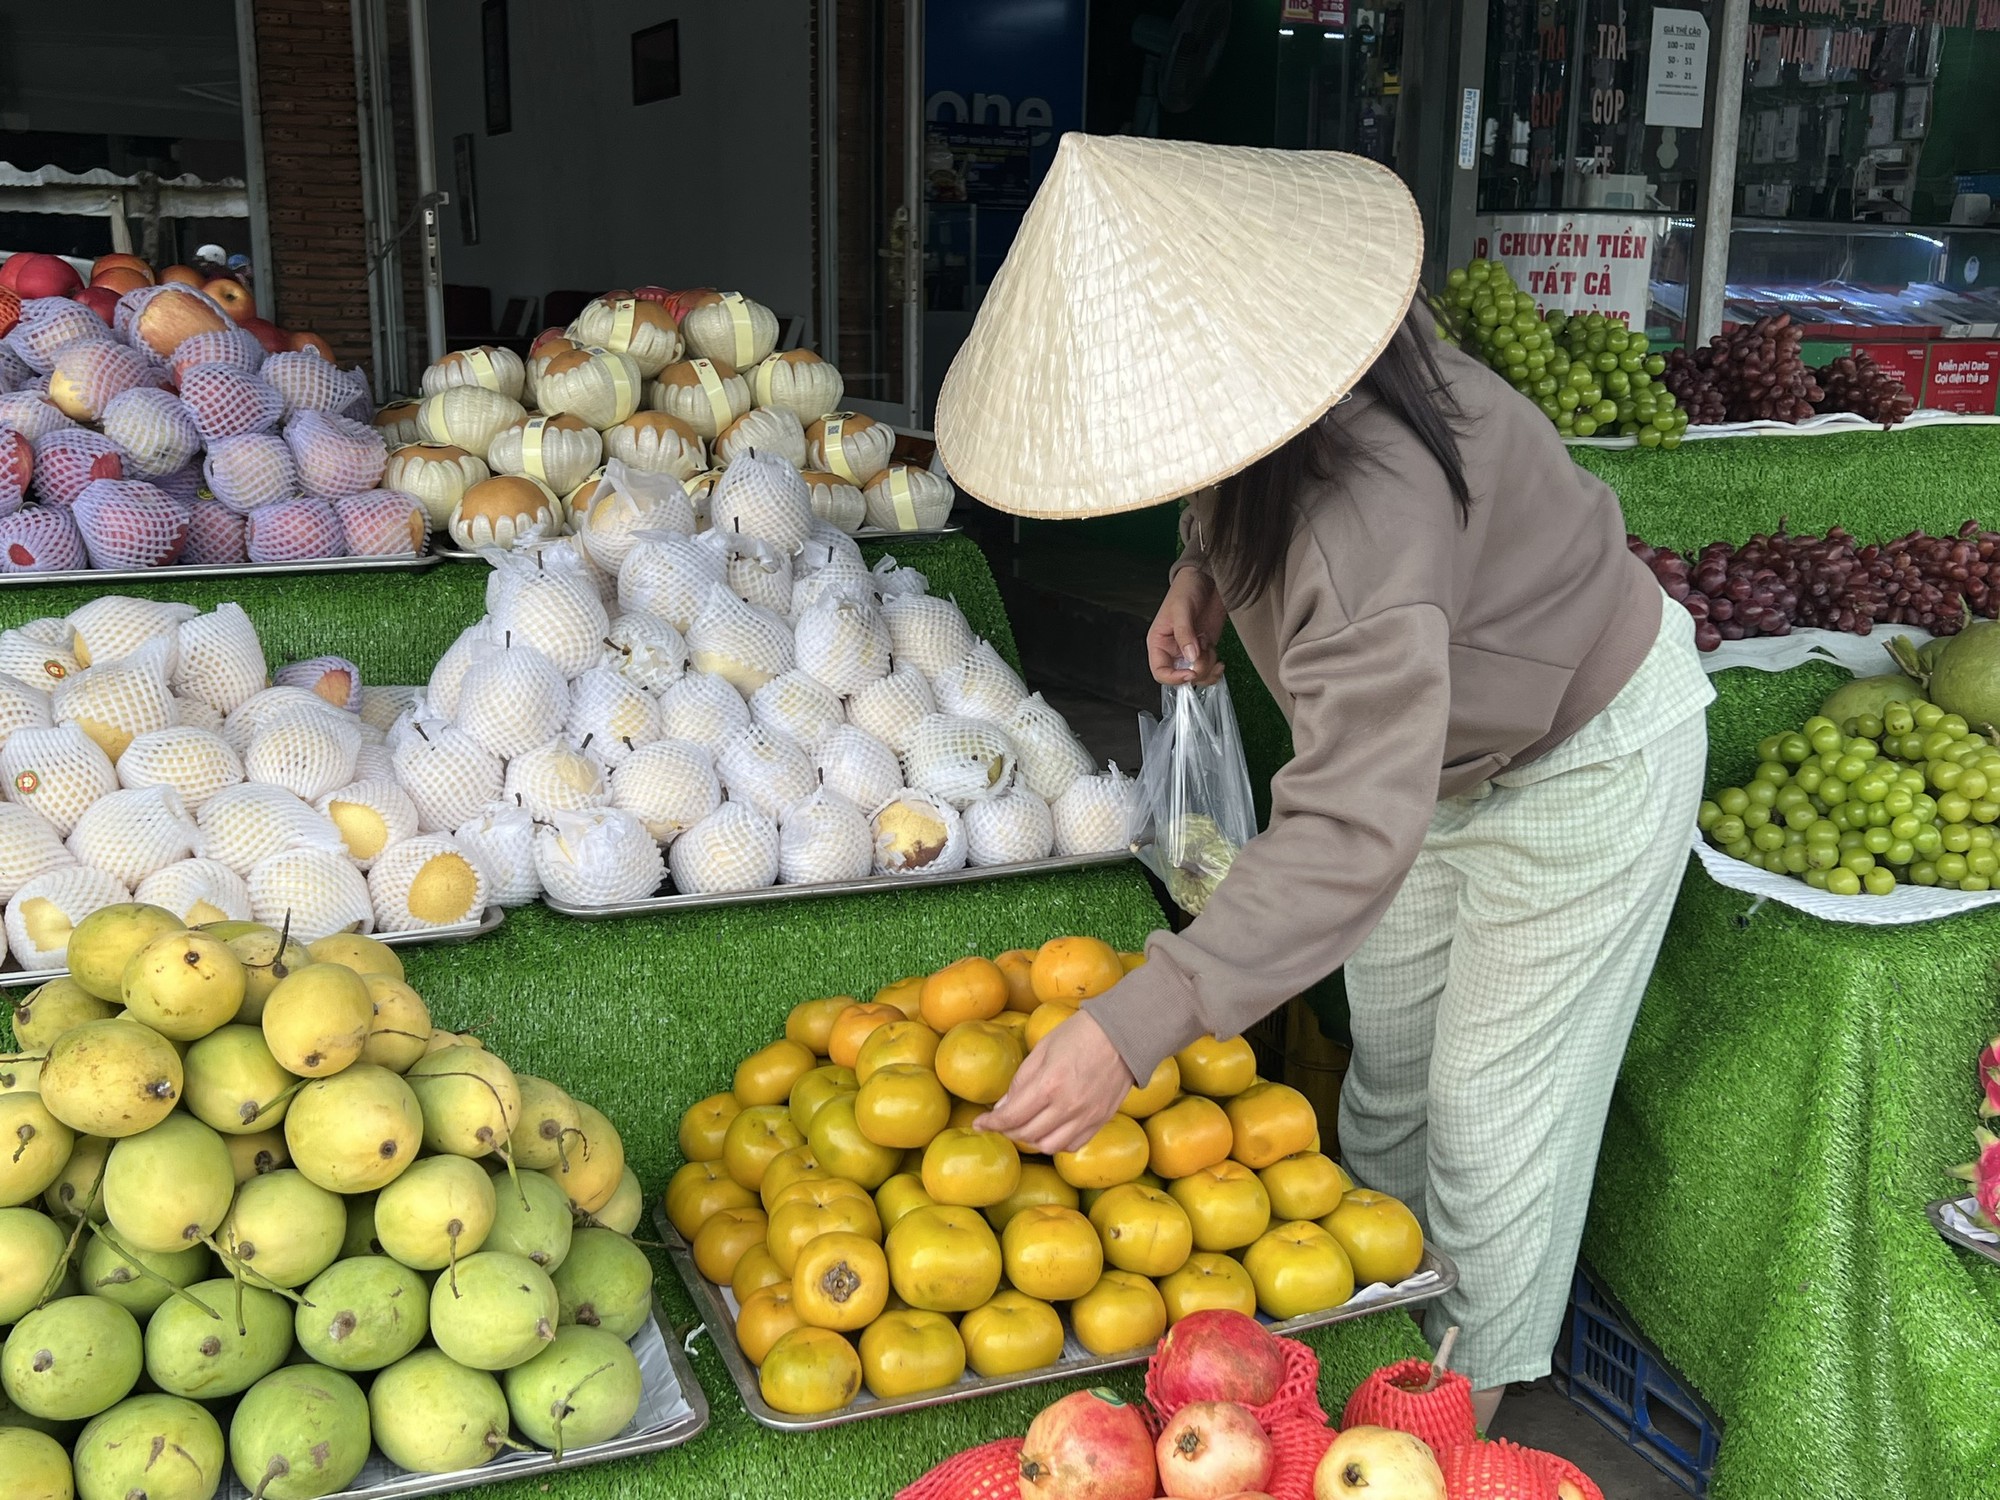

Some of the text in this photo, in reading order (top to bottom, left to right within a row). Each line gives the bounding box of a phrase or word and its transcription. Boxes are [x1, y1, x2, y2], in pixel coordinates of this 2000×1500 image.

[1597, 10, 1627, 61] TRẢ
[1667, 41, 1679, 50] 100
[1684, 42, 1696, 51] 102
[1779, 20, 1817, 64] MÀN
[1684, 57, 1692, 66] 51
[1684, 72, 1692, 80] 21
[926, 94, 1053, 147] one
[1500, 222, 1589, 257] CHUYỂN
[1597, 226, 1647, 259] TIỀN
[1528, 263, 1612, 296] TẤT CẢ
[1938, 359, 1990, 372] Miễn phí Data
[1934, 374, 1948, 385] Gọi
[1948, 373, 1965, 385] điện
[1979, 375, 1989, 385] ga
